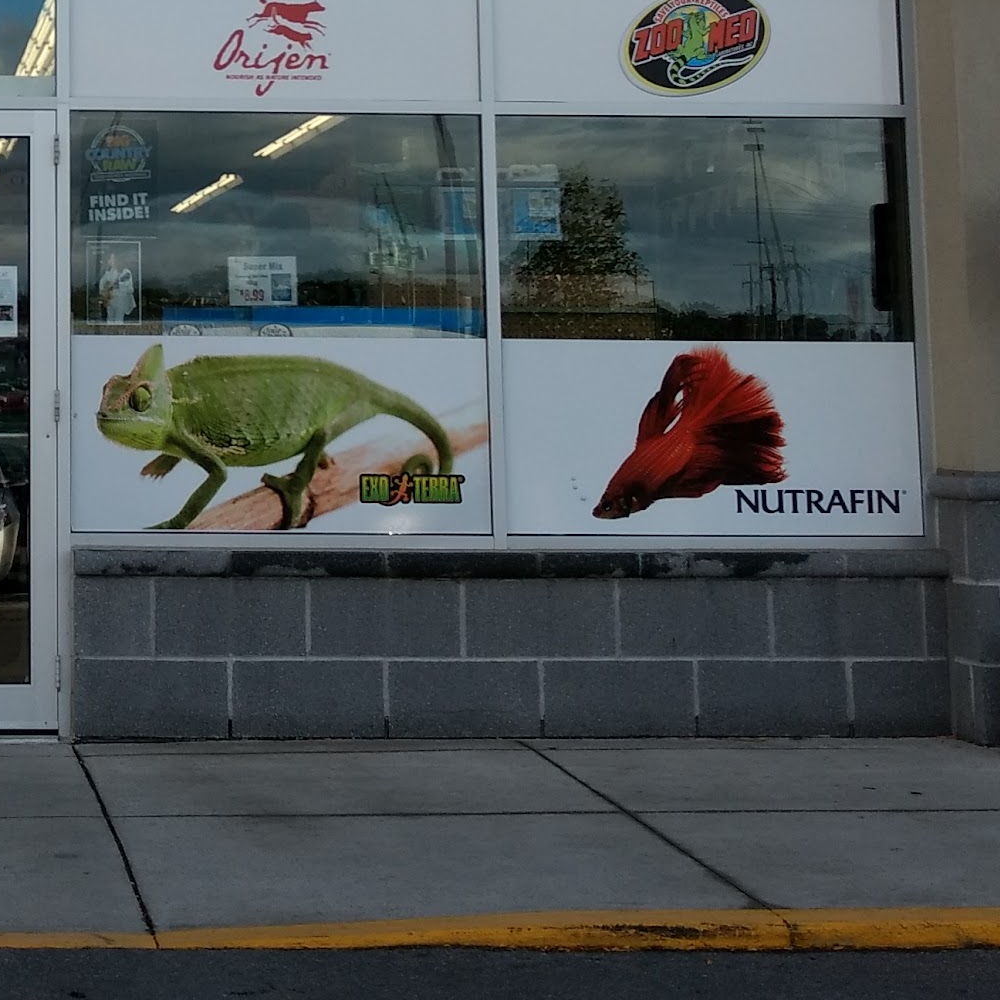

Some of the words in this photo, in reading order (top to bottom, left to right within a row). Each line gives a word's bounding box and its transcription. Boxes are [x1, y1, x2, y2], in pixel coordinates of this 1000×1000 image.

[655, 4, 670, 22] SAVE
[634, 18, 684, 62] ZOO
[708, 10, 758, 53] MED
[89, 193, 129, 209] FIND
[133, 192, 148, 206] IT
[88, 206, 150, 222] INSIDE!
[361, 475, 390, 502] EXO
[413, 476, 461, 503] TERRA
[735, 489, 900, 514] NUTRAFIN
